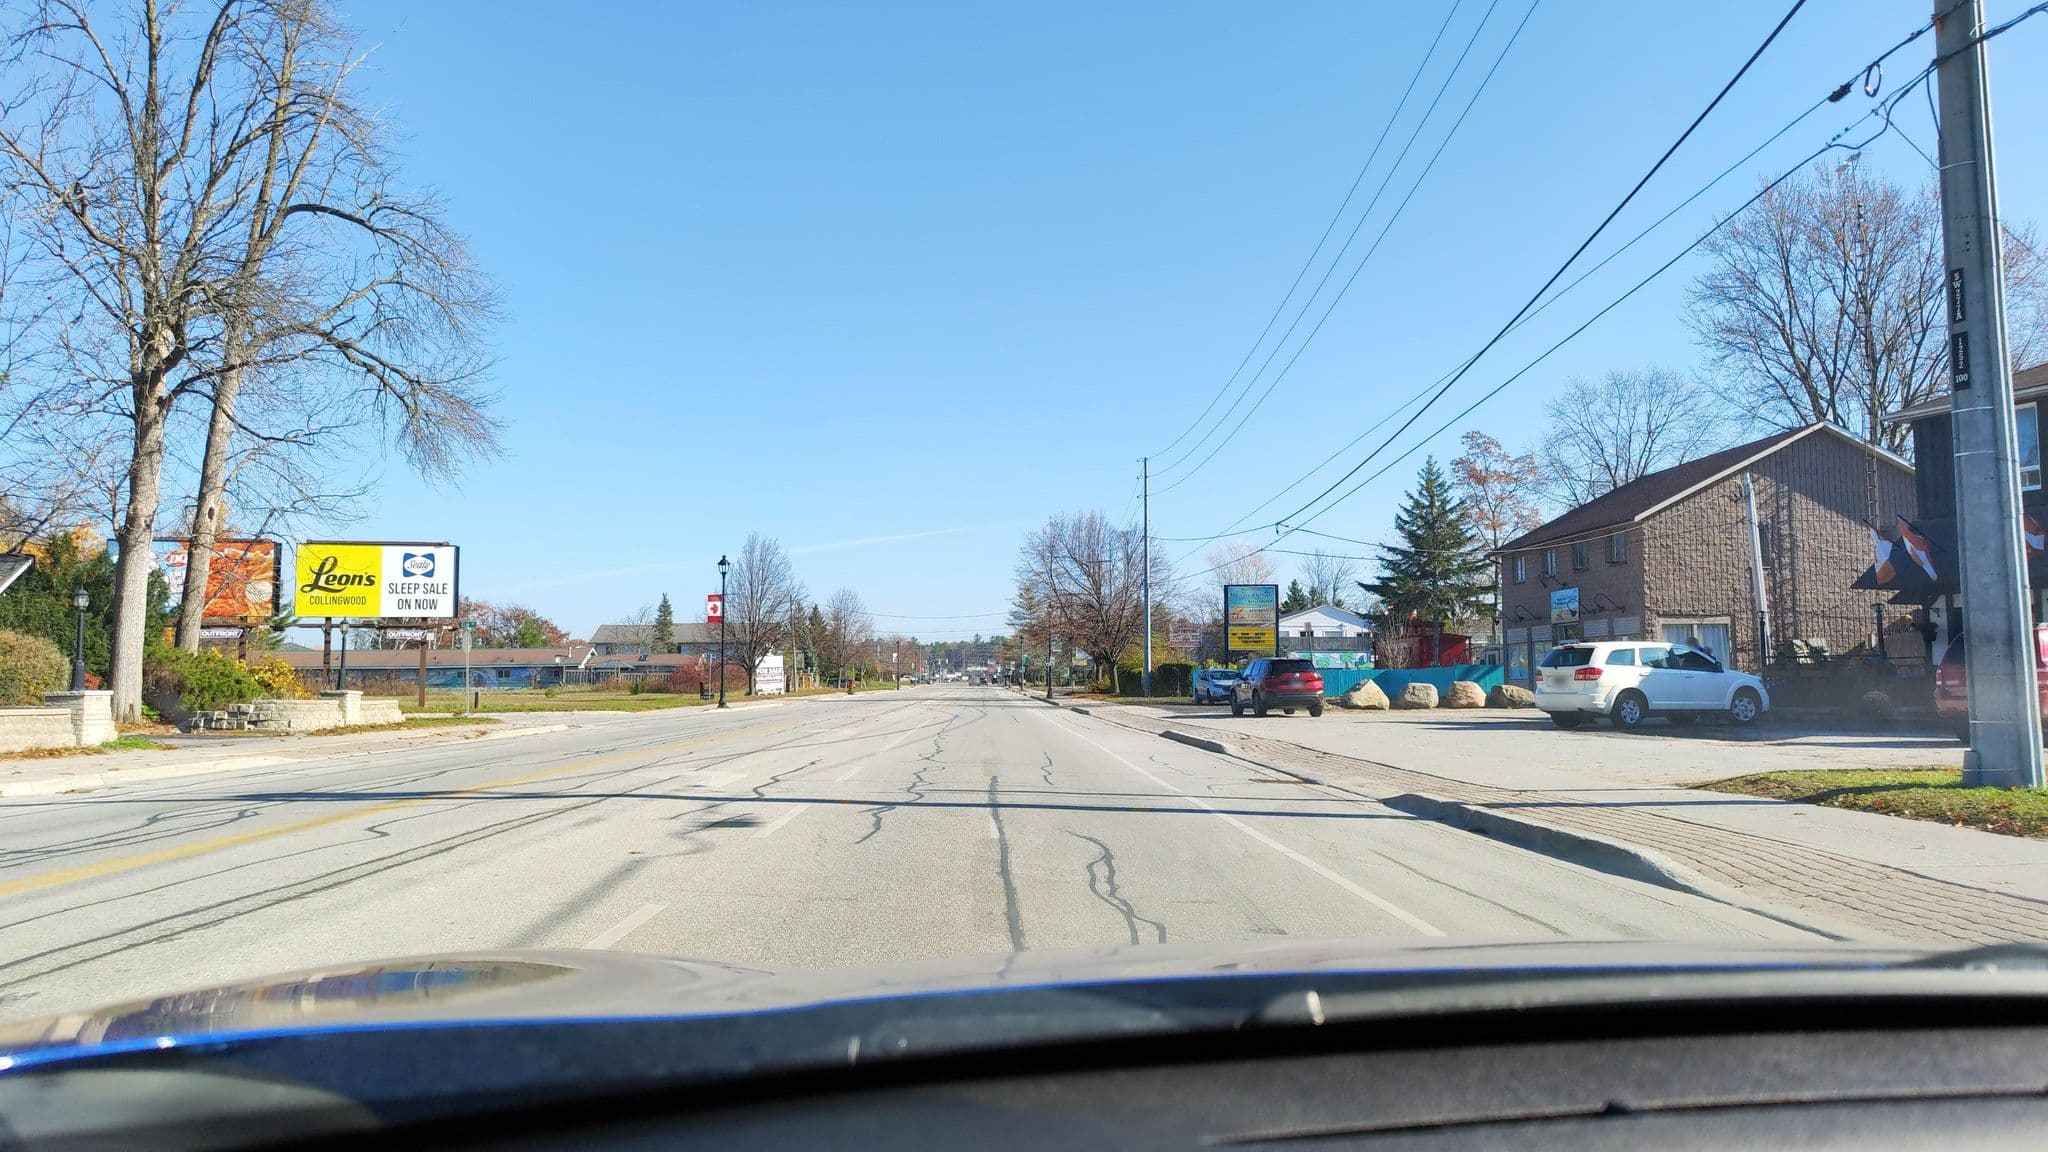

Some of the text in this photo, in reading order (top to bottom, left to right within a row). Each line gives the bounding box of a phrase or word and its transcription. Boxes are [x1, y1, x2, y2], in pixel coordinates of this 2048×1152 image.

[1955, 373, 1968, 383] 100
[407, 559, 431, 570] Sealy
[300, 555, 376, 593] Leon's
[388, 582, 448, 595] SLEEP SALE
[309, 595, 366, 605] COLLINGWOOD
[397, 598, 438, 610] ON NOW
